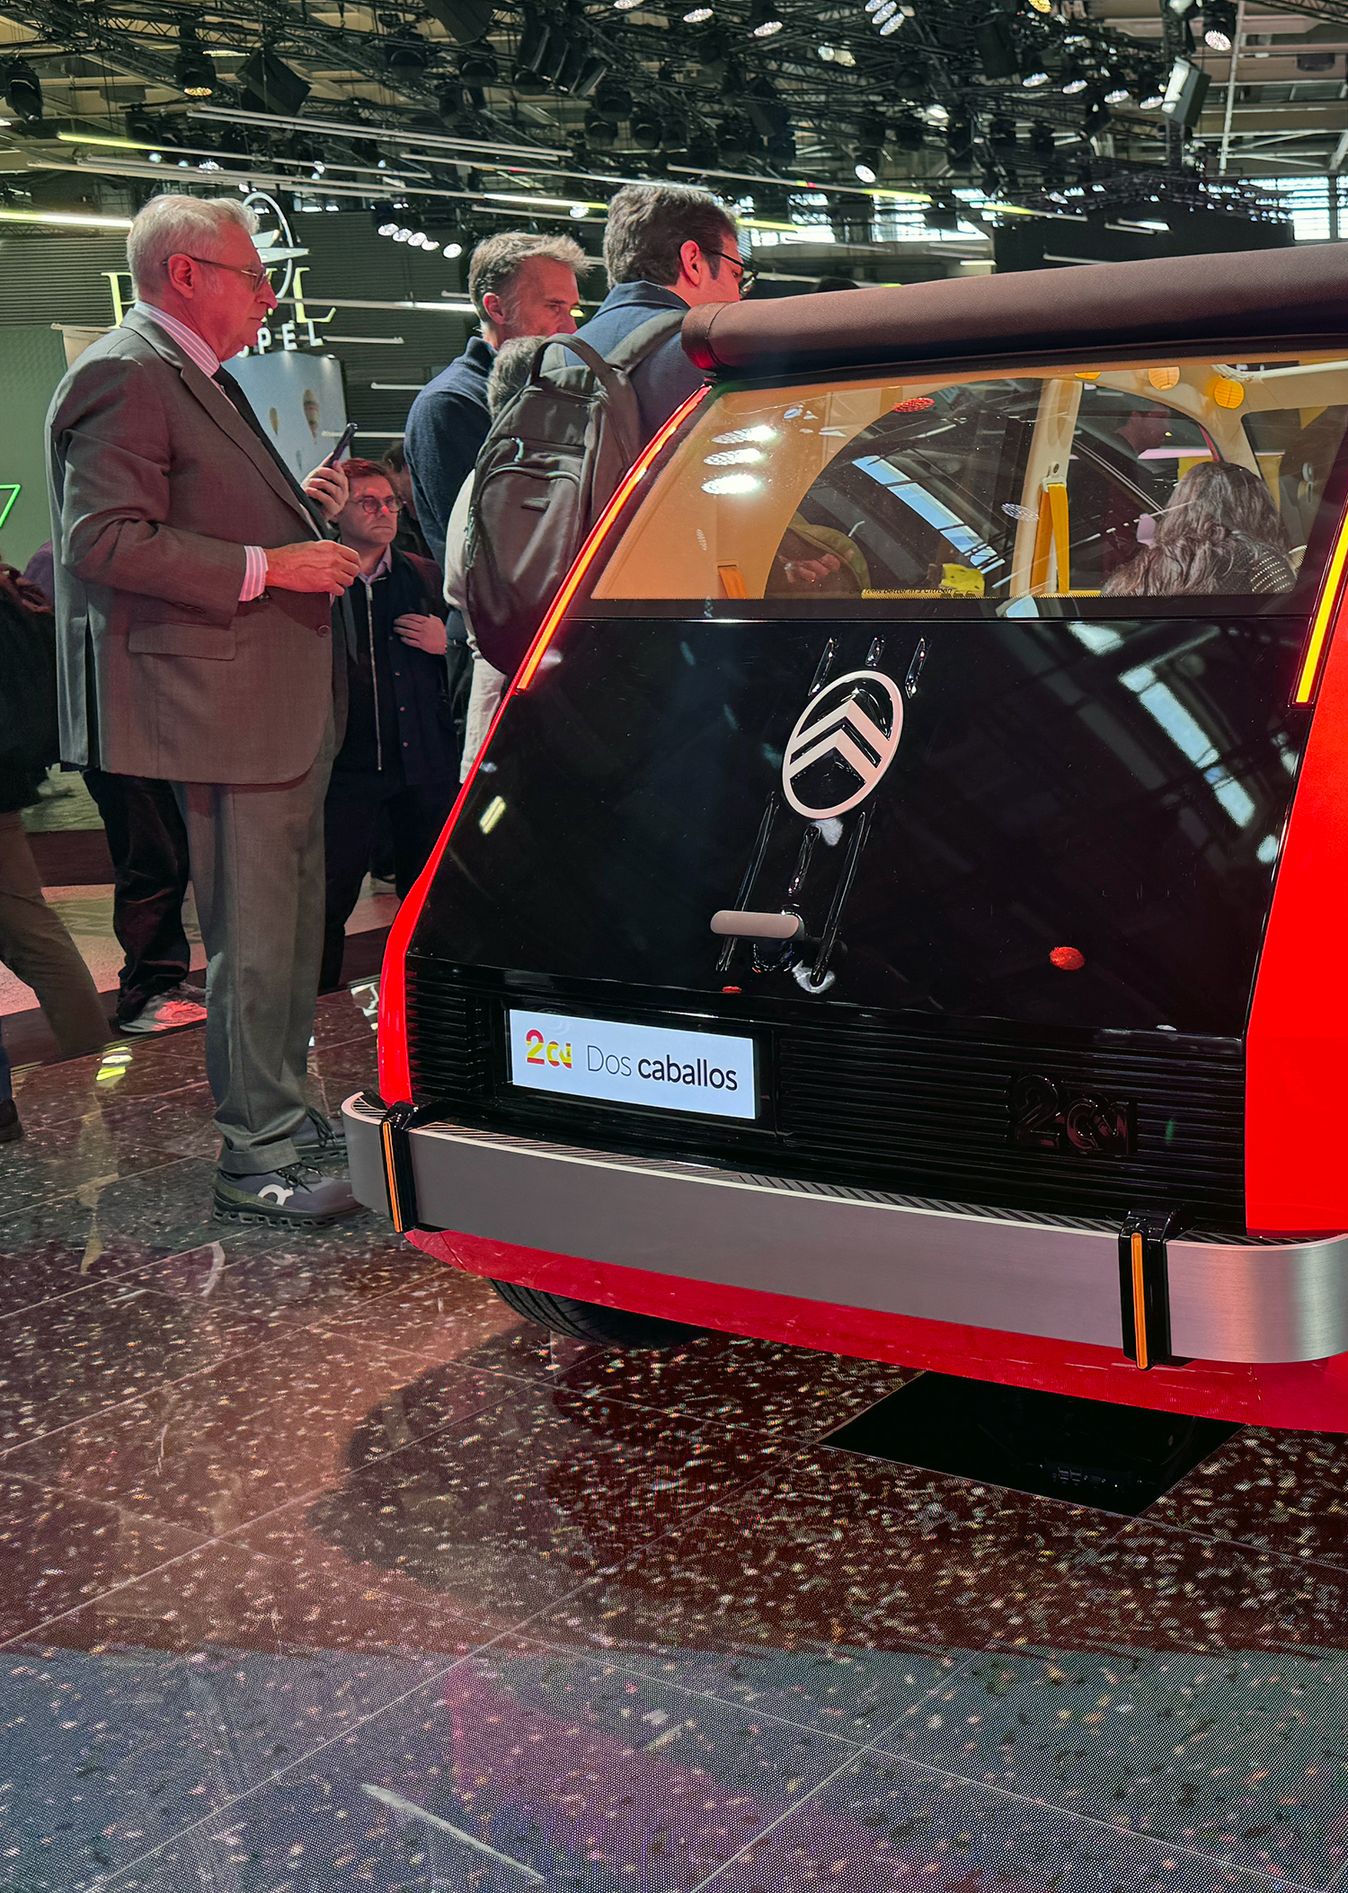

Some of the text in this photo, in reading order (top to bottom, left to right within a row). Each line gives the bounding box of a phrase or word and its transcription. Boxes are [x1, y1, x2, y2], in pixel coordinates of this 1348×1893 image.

[238, 320, 324, 358] PEL
[587, 1044, 632, 1077] Dos
[638, 1054, 738, 1091] caballos
